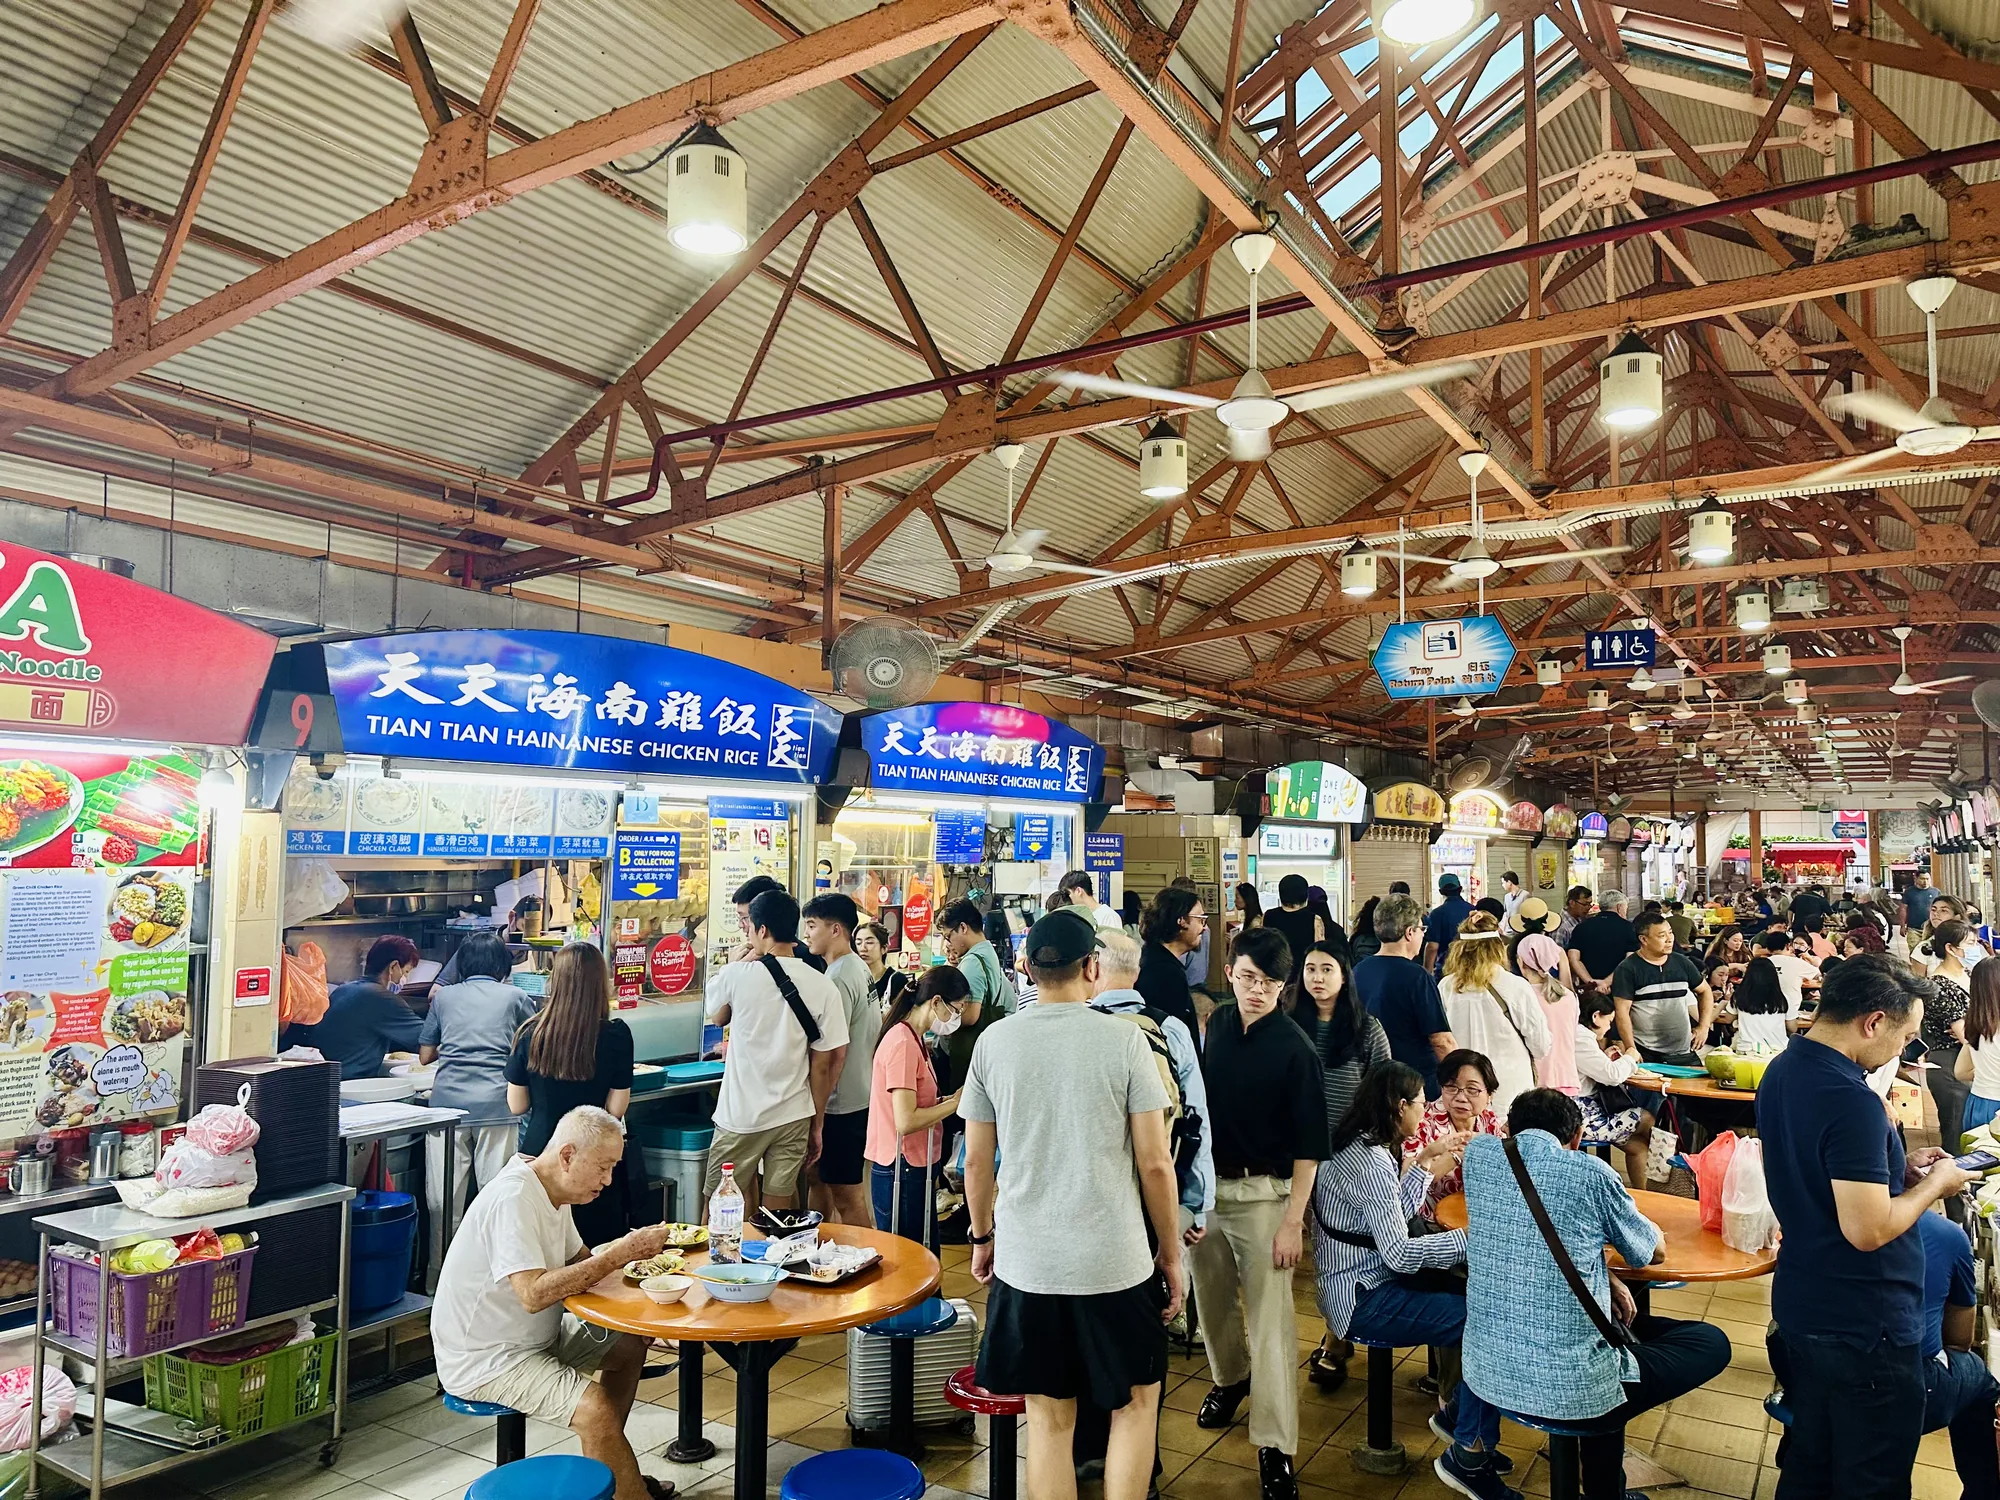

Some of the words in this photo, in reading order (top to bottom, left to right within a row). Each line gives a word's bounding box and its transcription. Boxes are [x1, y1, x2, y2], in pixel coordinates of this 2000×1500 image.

[0, 561, 91, 655] A
[0, 652, 101, 682] Noodle
[1409, 666, 1433, 676] Tray
[1390, 679, 1424, 688] Return
[1427, 676, 1455, 686] Point
[369, 651, 761, 741] 天天海南雞飯
[292, 694, 314, 746] 9
[366, 714, 431, 739] TIAN
[440, 722, 498, 744] TIAN
[506, 728, 633, 756] HAINANESE
[639, 741, 718, 762] CHICKEN
[724, 750, 759, 766] RICE
[878, 764, 907, 779] TIAN
[910, 766, 936, 781] TIAN
[940, 769, 998, 786] HAINANESE
[1001, 775, 1040, 789] CHICKEN
[1042, 779, 1061, 791] RICE
[1325, 780, 1338, 790] ONE
[1323, 794, 1336, 803] SOY
[1024, 820, 1030, 831] A
[670, 835, 676, 844] A
[620, 848, 631, 866] B
[122, 1064, 140, 1072] mouth
[0, 1091, 25, 1100] plemented
